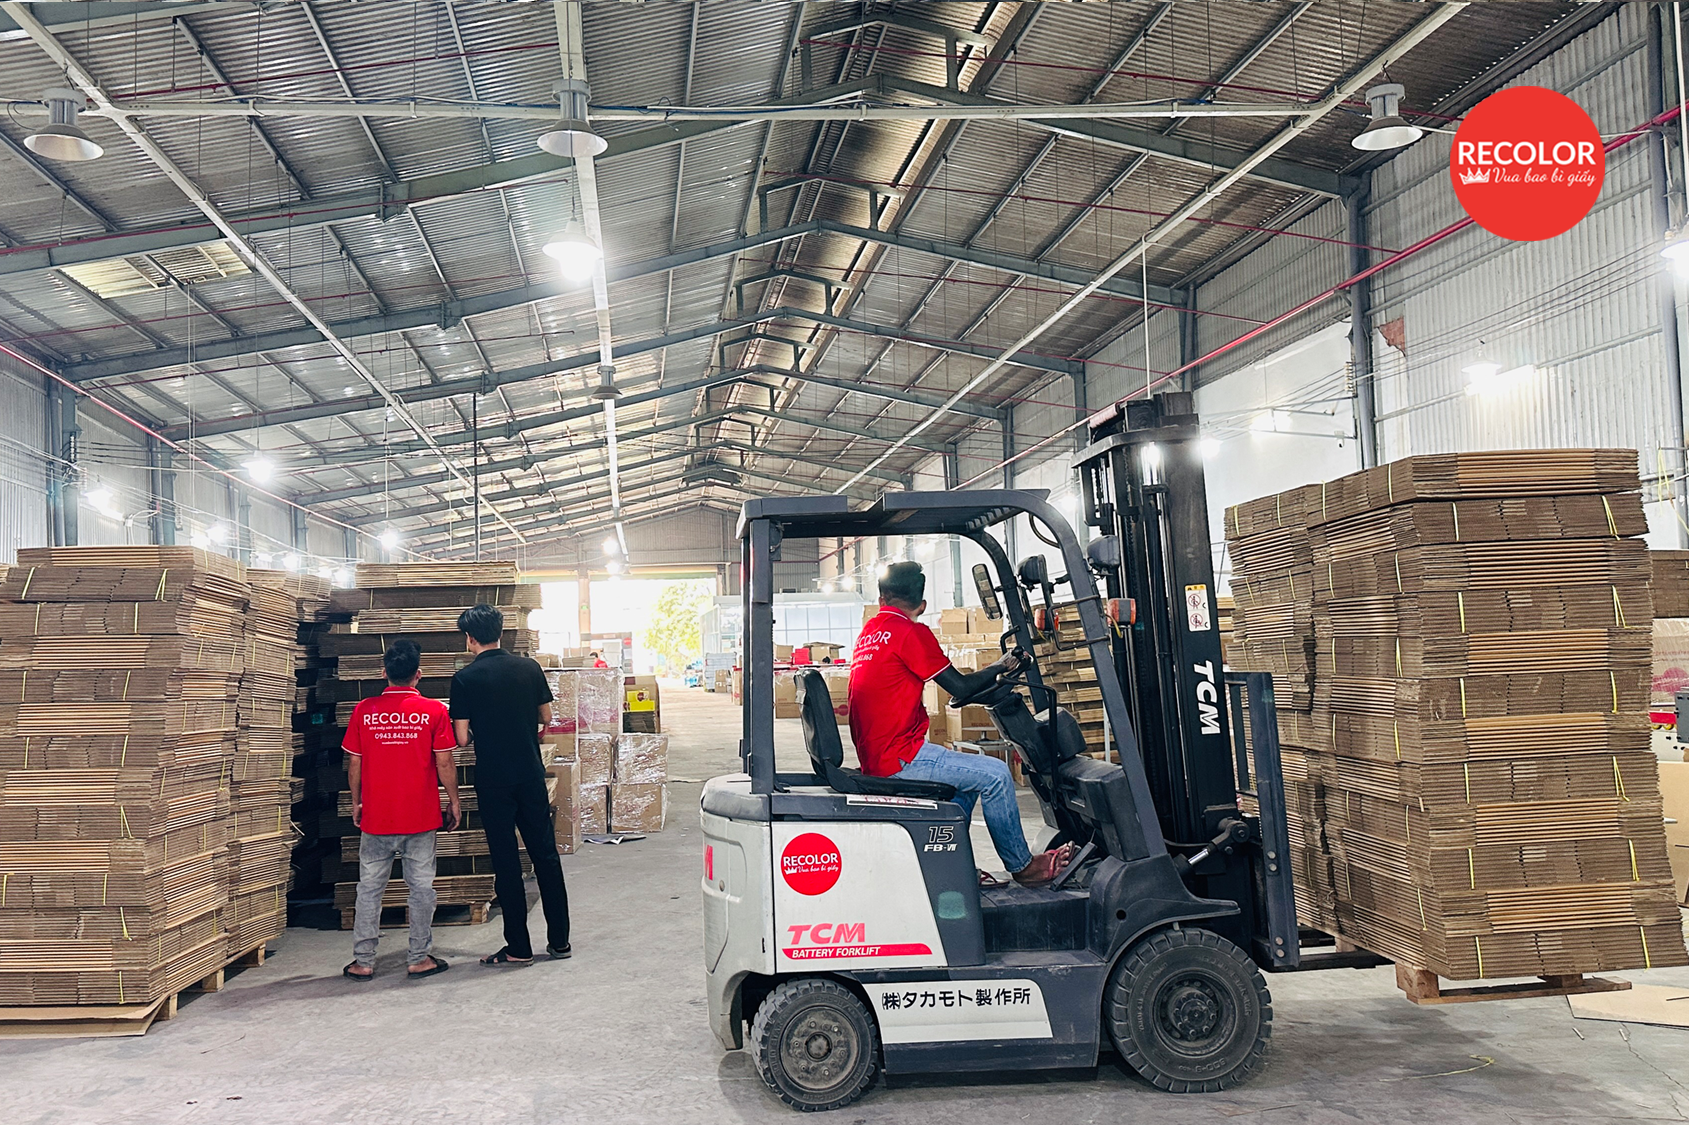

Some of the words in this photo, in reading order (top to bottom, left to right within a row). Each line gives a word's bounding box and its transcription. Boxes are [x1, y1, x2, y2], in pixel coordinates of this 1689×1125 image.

[1193, 659, 1221, 735] TCM
[363, 712, 430, 726] RECOLOR
[374, 732, 418, 740] 0943.843.868
[928, 825, 954, 844] 15
[783, 853, 839, 867] RECOLOR
[787, 922, 865, 945] TCM
[792, 948, 834, 958] BATTERY
[836, 946, 881, 957] FORKLIFT
